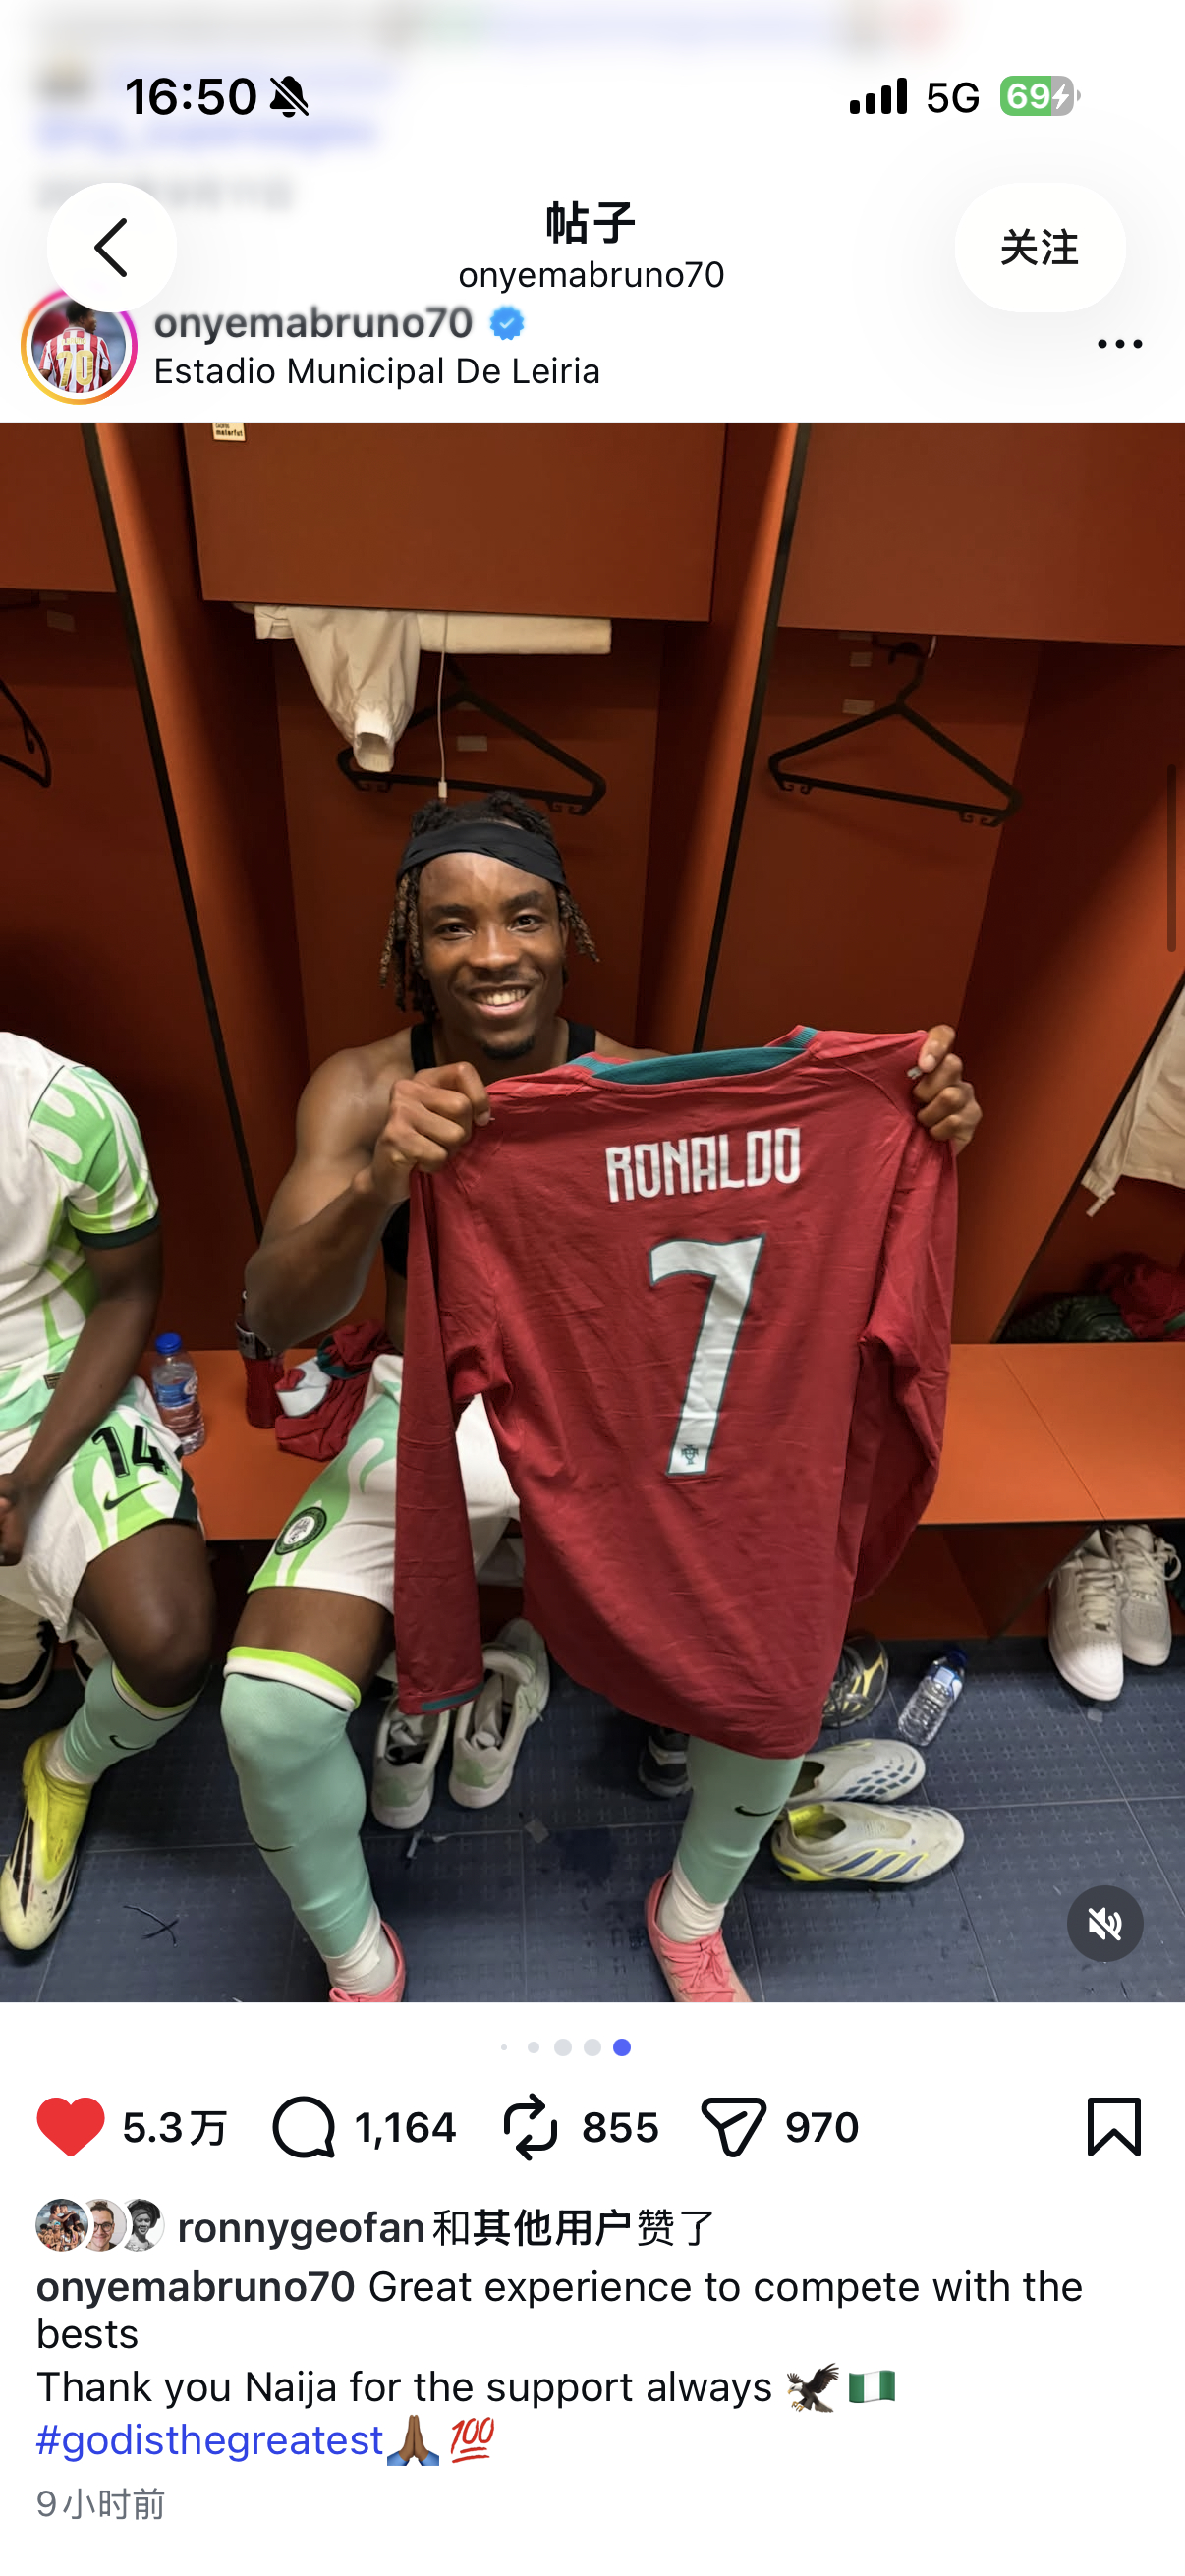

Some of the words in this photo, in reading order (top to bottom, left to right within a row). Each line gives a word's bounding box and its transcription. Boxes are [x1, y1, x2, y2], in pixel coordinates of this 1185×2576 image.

[56, 350, 94, 387] 70
[605, 1127, 800, 1203] RONALDO
[649, 1233, 766, 1476] 7
[91, 1425, 170, 1478] 14
